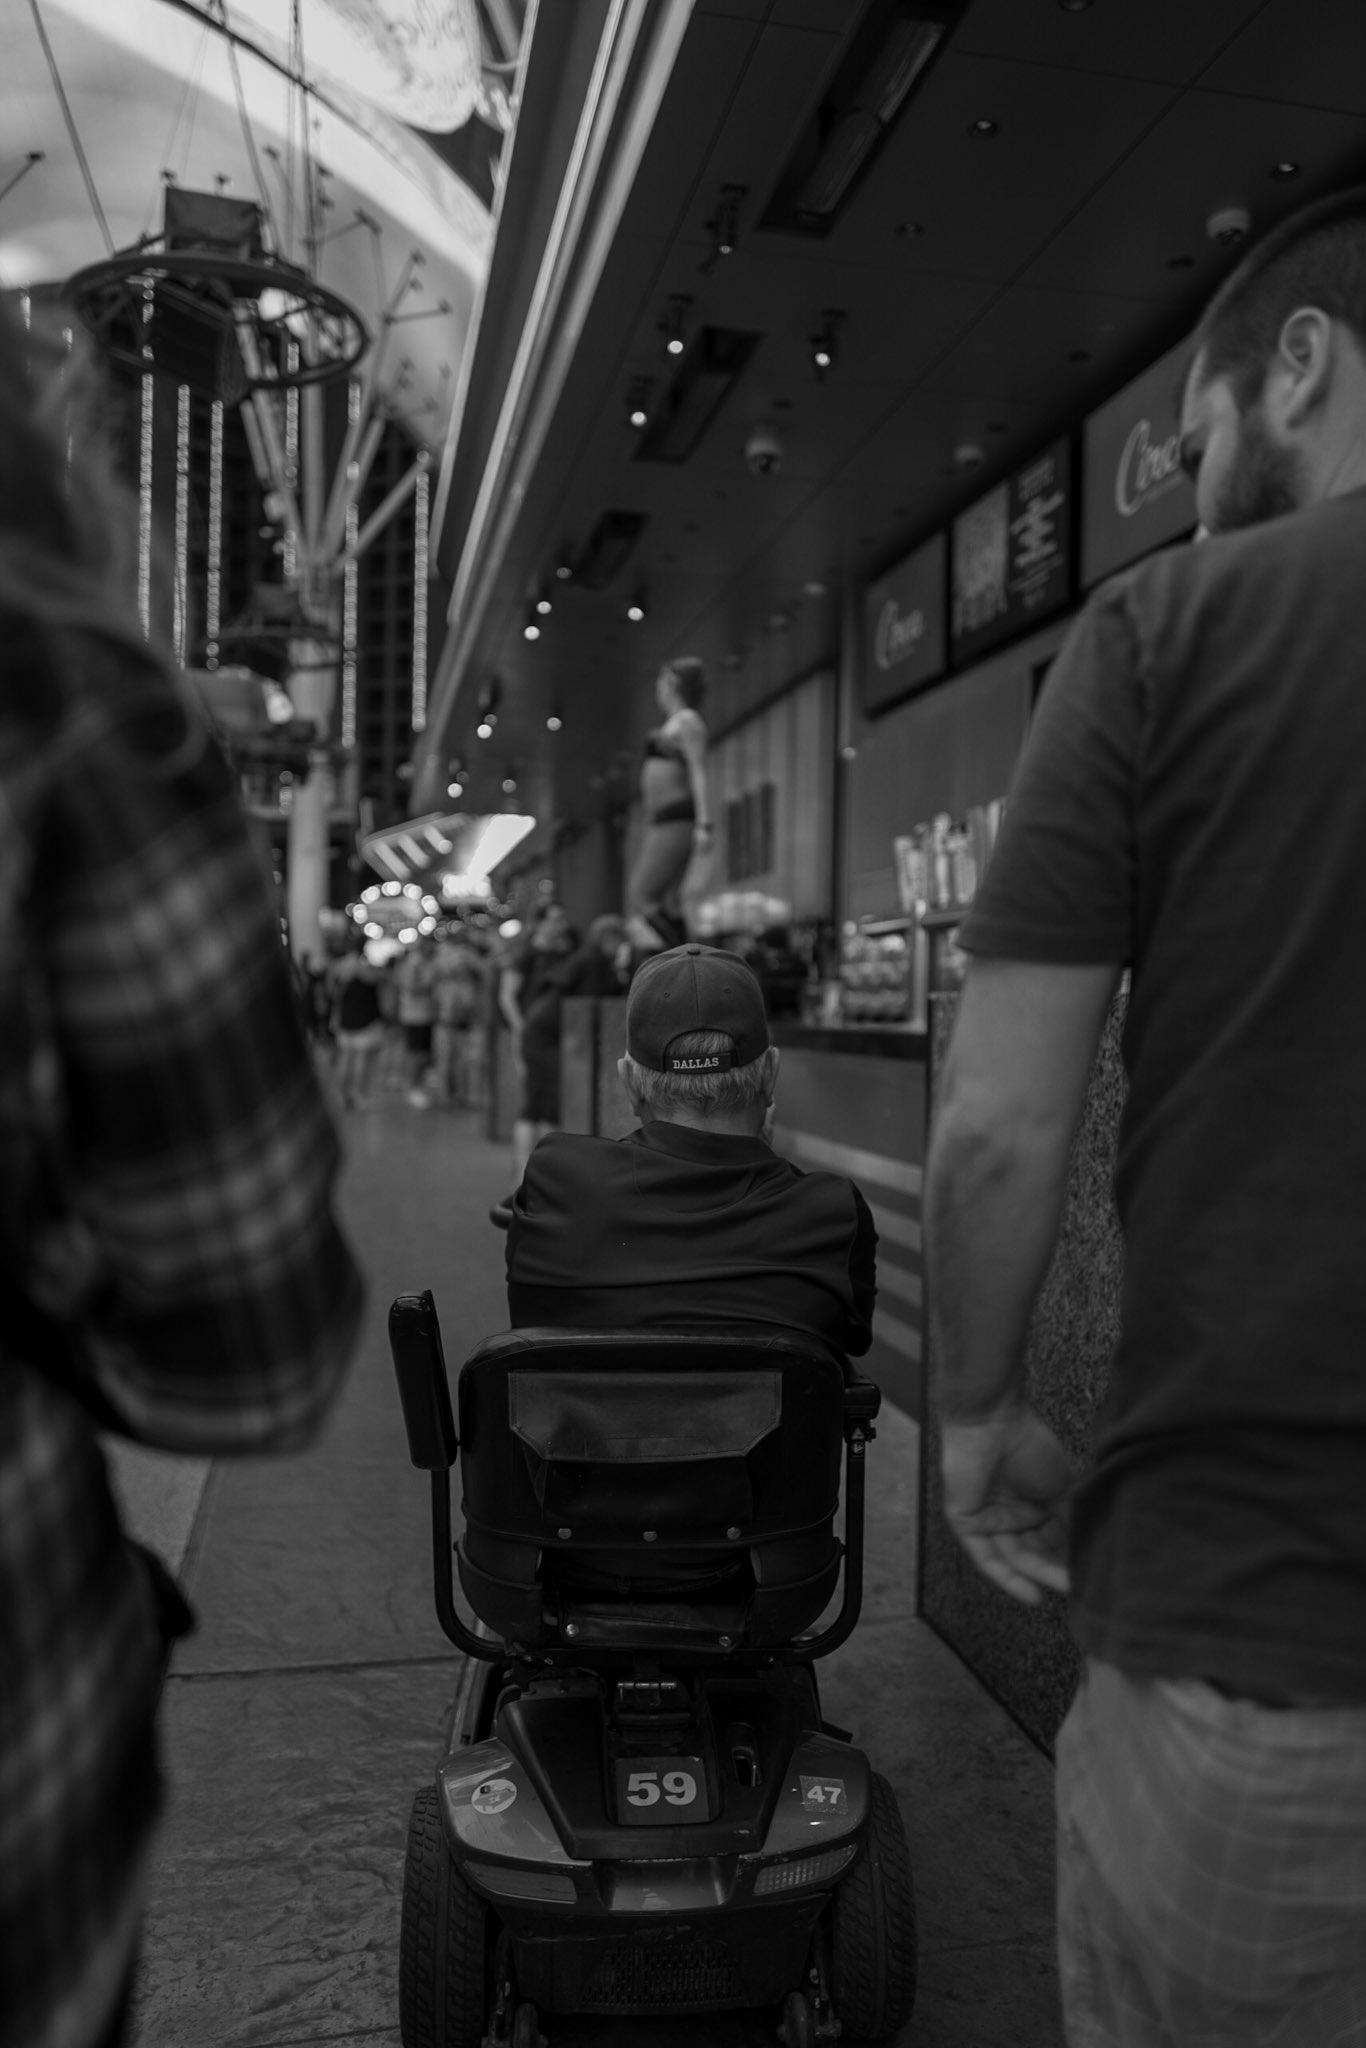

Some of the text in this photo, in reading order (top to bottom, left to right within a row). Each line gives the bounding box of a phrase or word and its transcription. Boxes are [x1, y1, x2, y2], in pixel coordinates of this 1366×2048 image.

[672, 1057, 719, 1069] DALLAS
[626, 1771, 697, 1807] 59
[806, 1784, 842, 1806] 47
